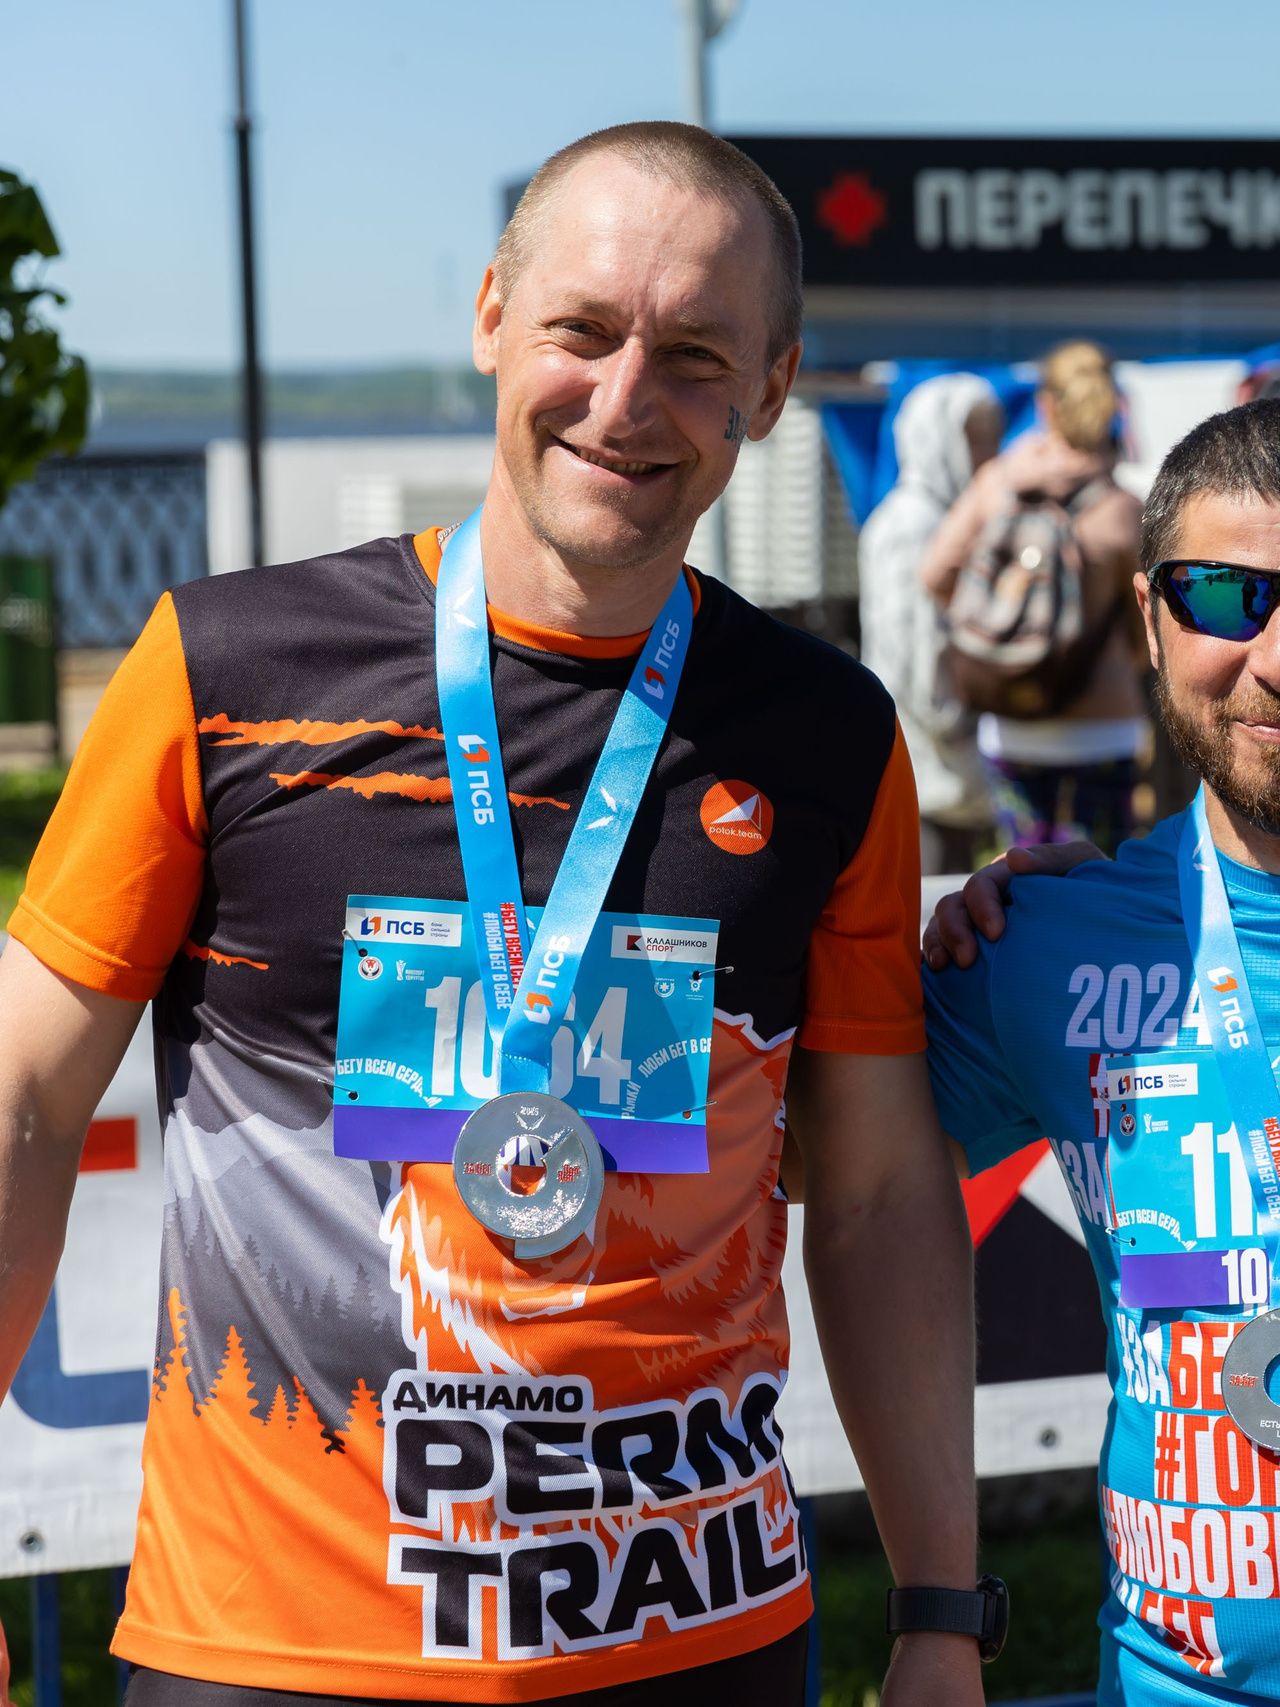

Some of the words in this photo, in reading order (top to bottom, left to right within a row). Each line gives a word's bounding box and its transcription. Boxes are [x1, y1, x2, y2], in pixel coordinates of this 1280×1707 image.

[655, 618, 681, 669] ПСБ
[467, 770, 495, 825] ПСБ
[708, 826, 762, 840] potok.team
[386, 921, 425, 936] ПСБ
[646, 937, 708, 948] КАЛАШНИКОВ
[489, 952, 508, 972] БЕГ
[535, 935, 571, 989] ПСБ
[646, 944, 675, 953] СПОРТ
[1065, 963, 1214, 1049] 2024
[1219, 995, 1249, 1049] ПСБ
[336, 1058, 364, 1076] БЕГУ
[365, 1058, 396, 1077] ВСЕМ
[638, 1048, 671, 1078] ЛЮБИ
[669, 1040, 688, 1060] БЕГ
[690, 1039, 699, 1054] В
[1134, 1076, 1164, 1091] ПСБ
[1248, 1129, 1271, 1167] #ЛЮБИ
[1257, 1165, 1277, 1184] БЕГ
[1263, 1186, 1279, 1194] В
[1116, 1210, 1136, 1227] БЕГУ
[1136, 1209, 1158, 1225] ВСЕМ
[1116, 1313, 1250, 1412] #ЗАБЕ
[395, 1381, 583, 1413] ДИНАМО
[396, 1383, 784, 1519] PERM
[401, 1499, 797, 1648] TRAIL
